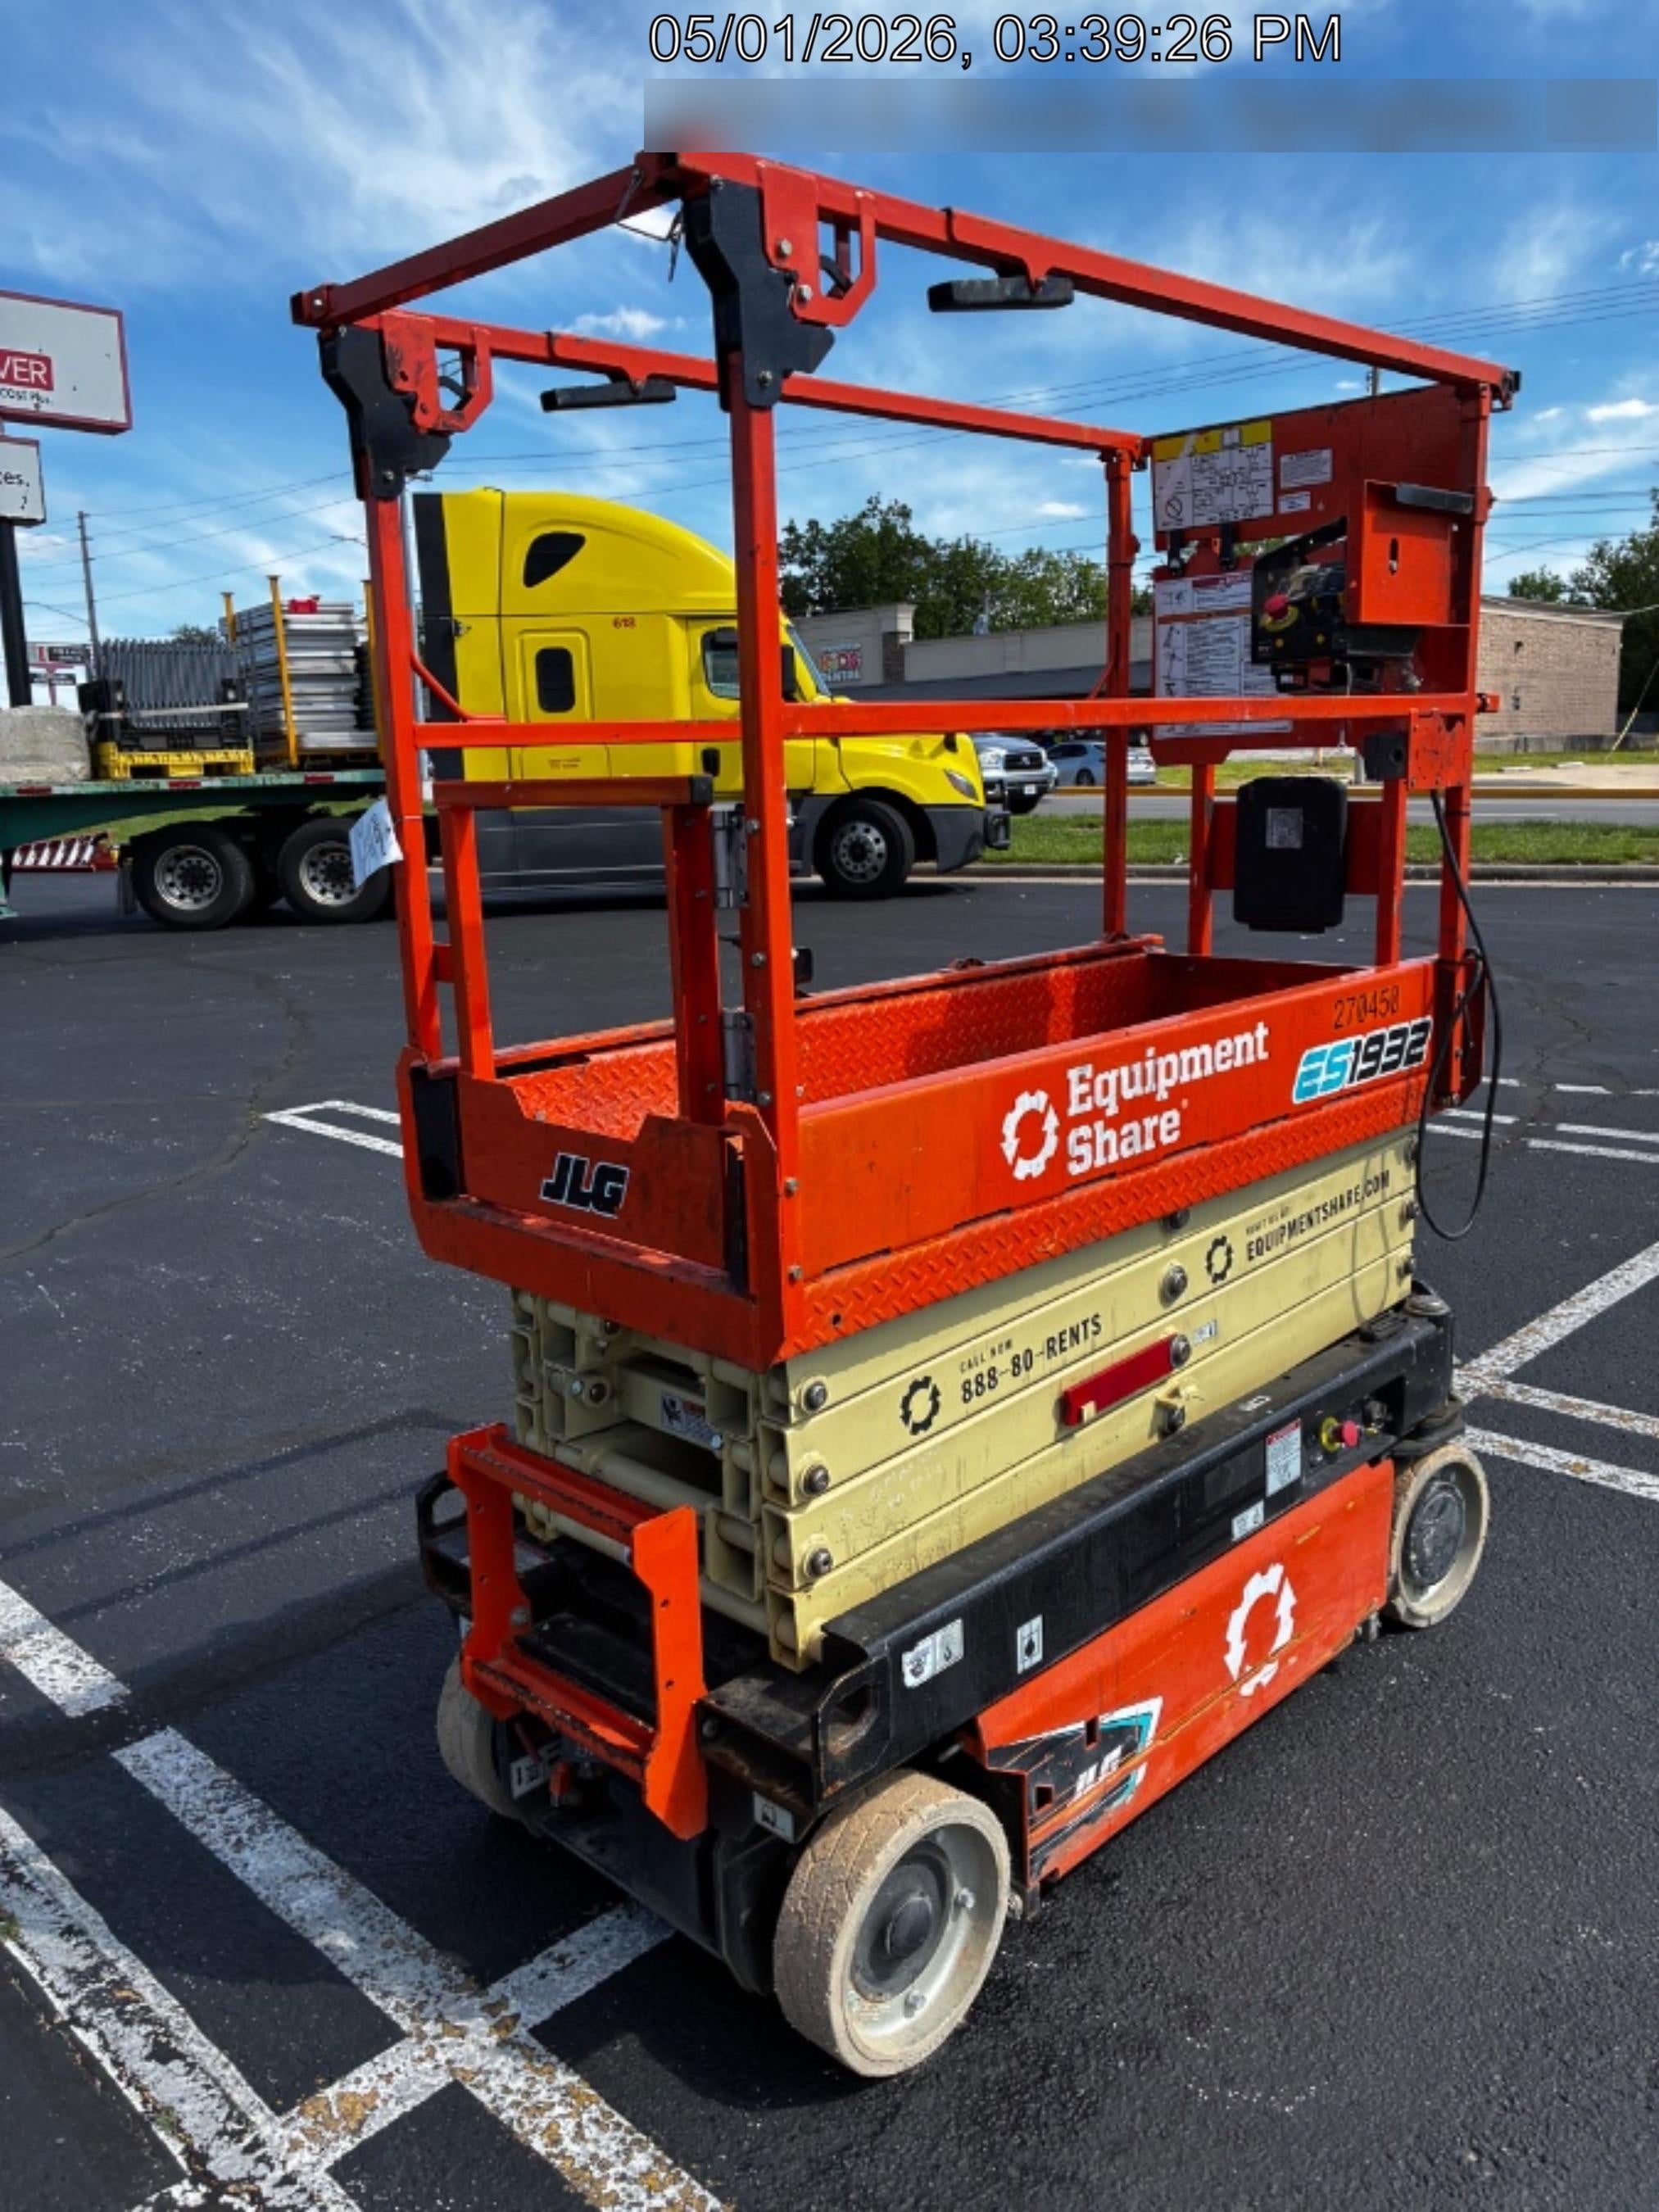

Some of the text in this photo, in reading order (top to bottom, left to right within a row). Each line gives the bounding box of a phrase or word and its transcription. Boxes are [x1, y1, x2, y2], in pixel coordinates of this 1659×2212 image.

[1067, 1021, 1269, 1117] Equipment
[1293, 1014, 1433, 1104] ES1932
[538, 1150, 630, 1220] JLG
[1067, 1108, 1181, 1176] Share
[1246, 1169, 1390, 1262] EQUIPMENTSHARE.COM
[961, 1312, 1103, 1404] 888-80-RENTS
